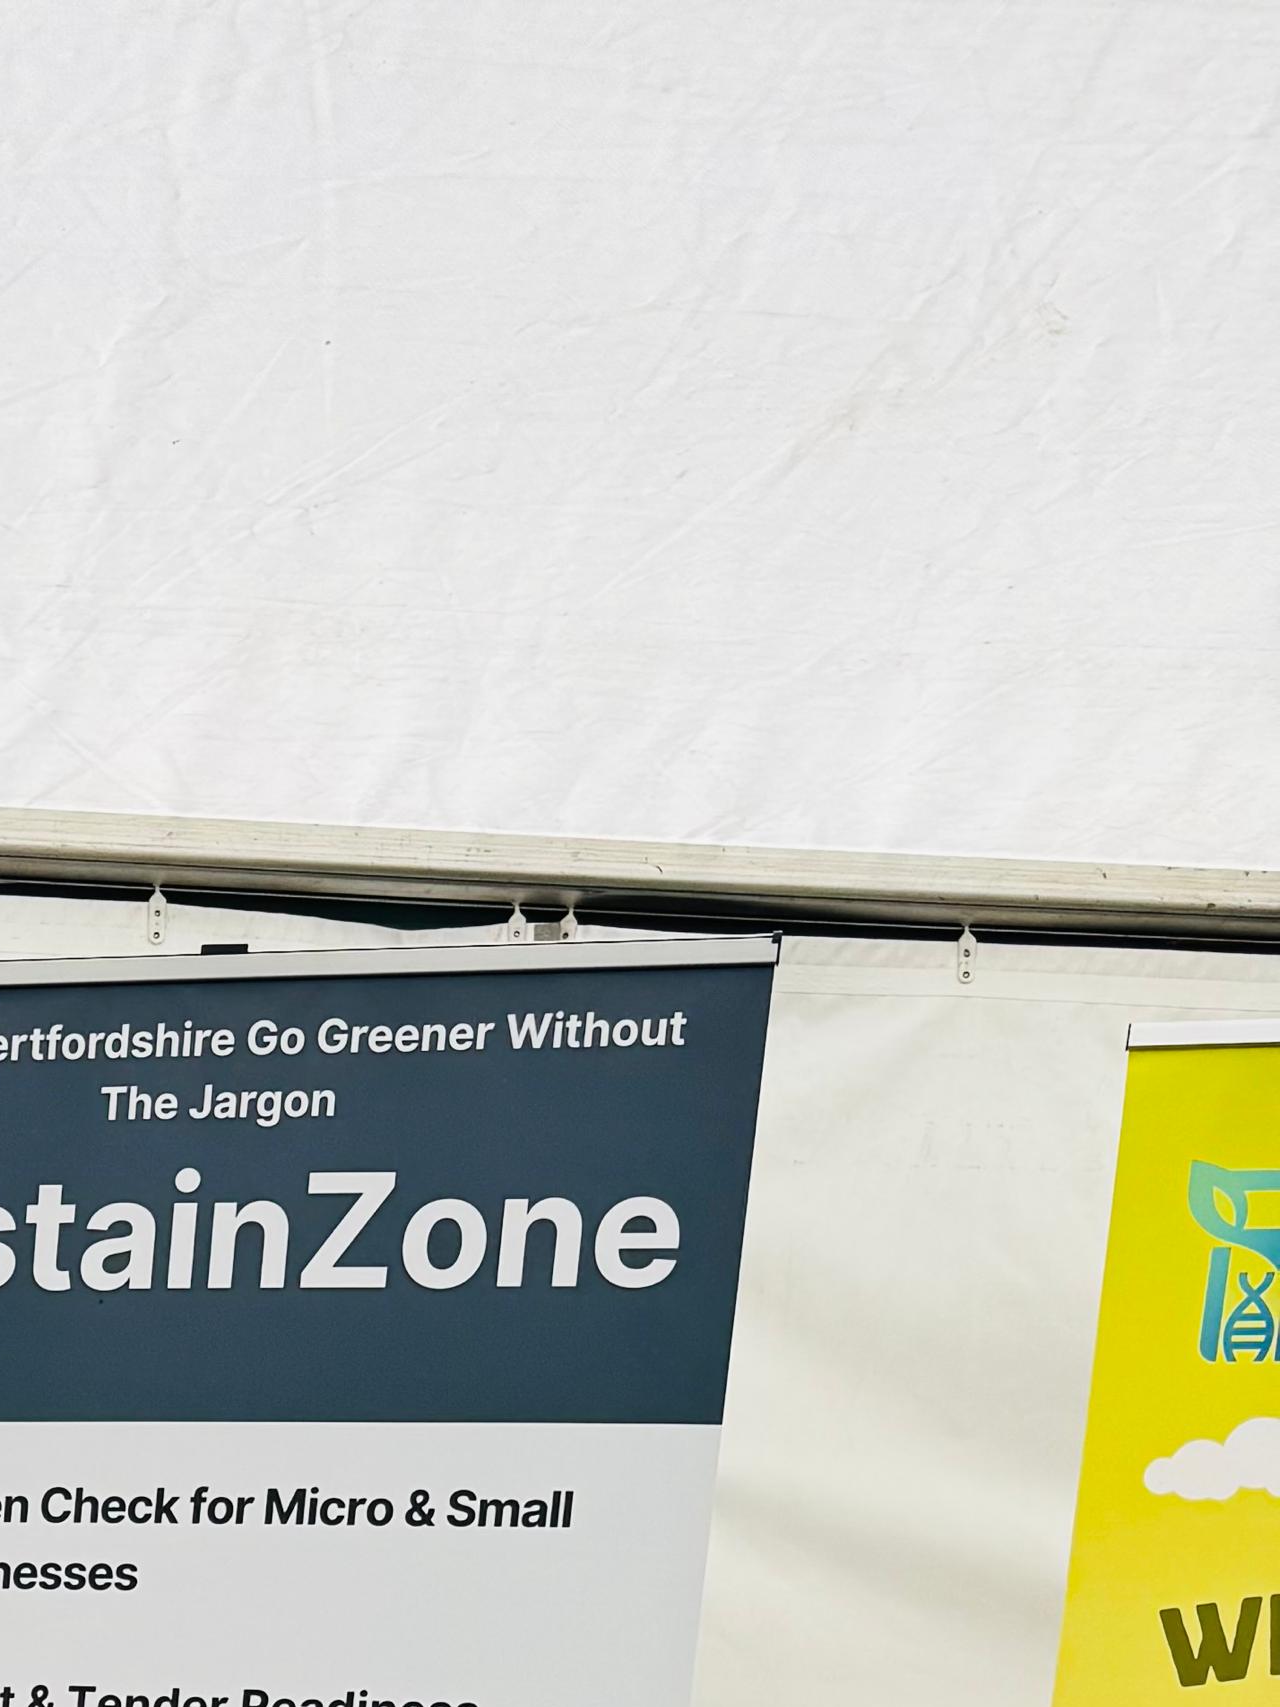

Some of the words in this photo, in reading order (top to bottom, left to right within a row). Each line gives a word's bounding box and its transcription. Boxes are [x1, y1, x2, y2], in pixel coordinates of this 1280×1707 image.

[247, 1019, 305, 1057] Go
[316, 1014, 496, 1055] Greener
[507, 1012, 687, 1051] Without
[101, 1087, 179, 1121] The
[189, 1083, 336, 1126] Jargon
[40, 1486, 179, 1527] Check
[189, 1487, 255, 1525] for
[264, 1488, 394, 1527] Micro
[405, 1491, 436, 1527] &
[447, 1489, 574, 1529] Small
